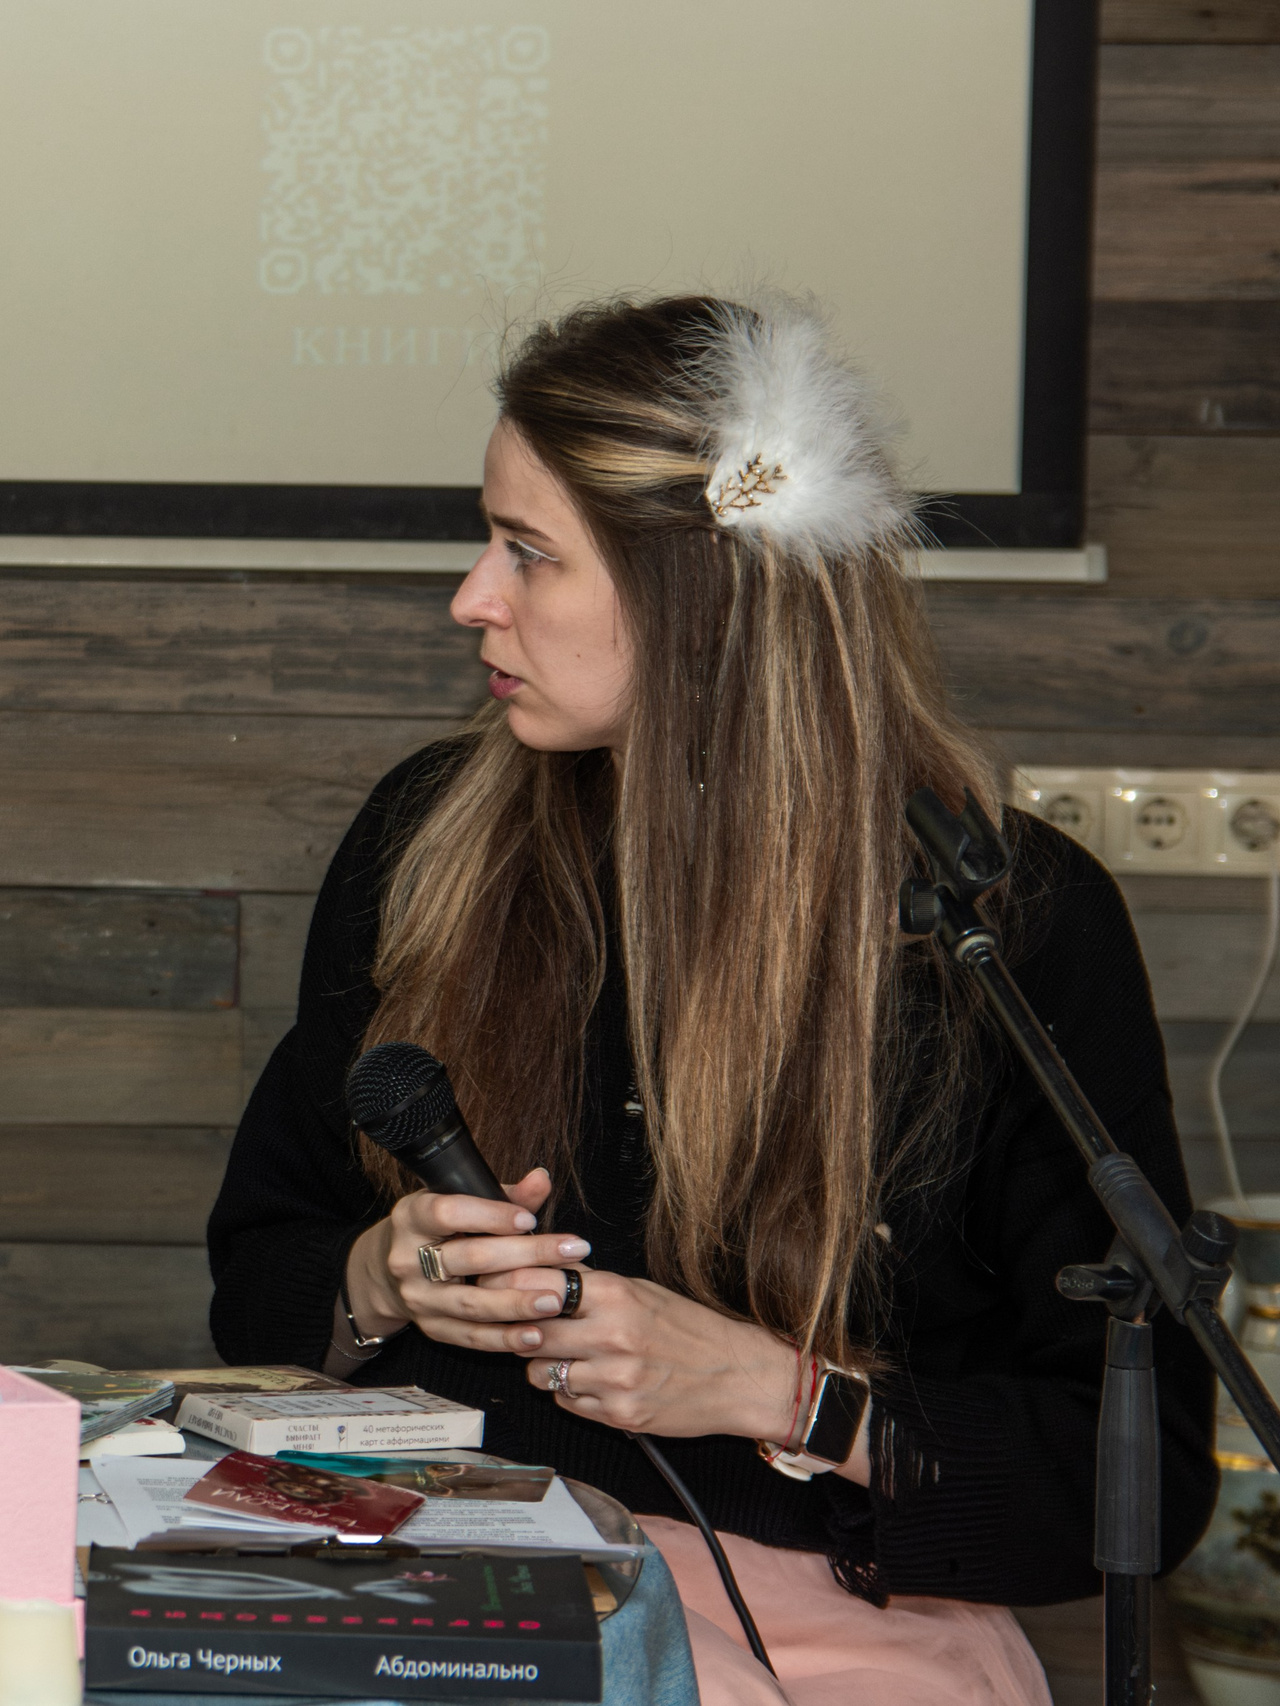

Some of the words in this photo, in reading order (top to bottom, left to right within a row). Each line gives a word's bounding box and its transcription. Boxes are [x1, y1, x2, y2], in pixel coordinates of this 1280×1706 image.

[362, 1423, 374, 1434] 40
[375, 1422, 445, 1436] метафорических
[359, 1438, 378, 1448] карт
[386, 1435, 450, 1447] аффирмациями
[128, 1646, 191, 1670] Ольга
[196, 1648, 283, 1675] Черных
[375, 1654, 539, 1681] Абдоминально
